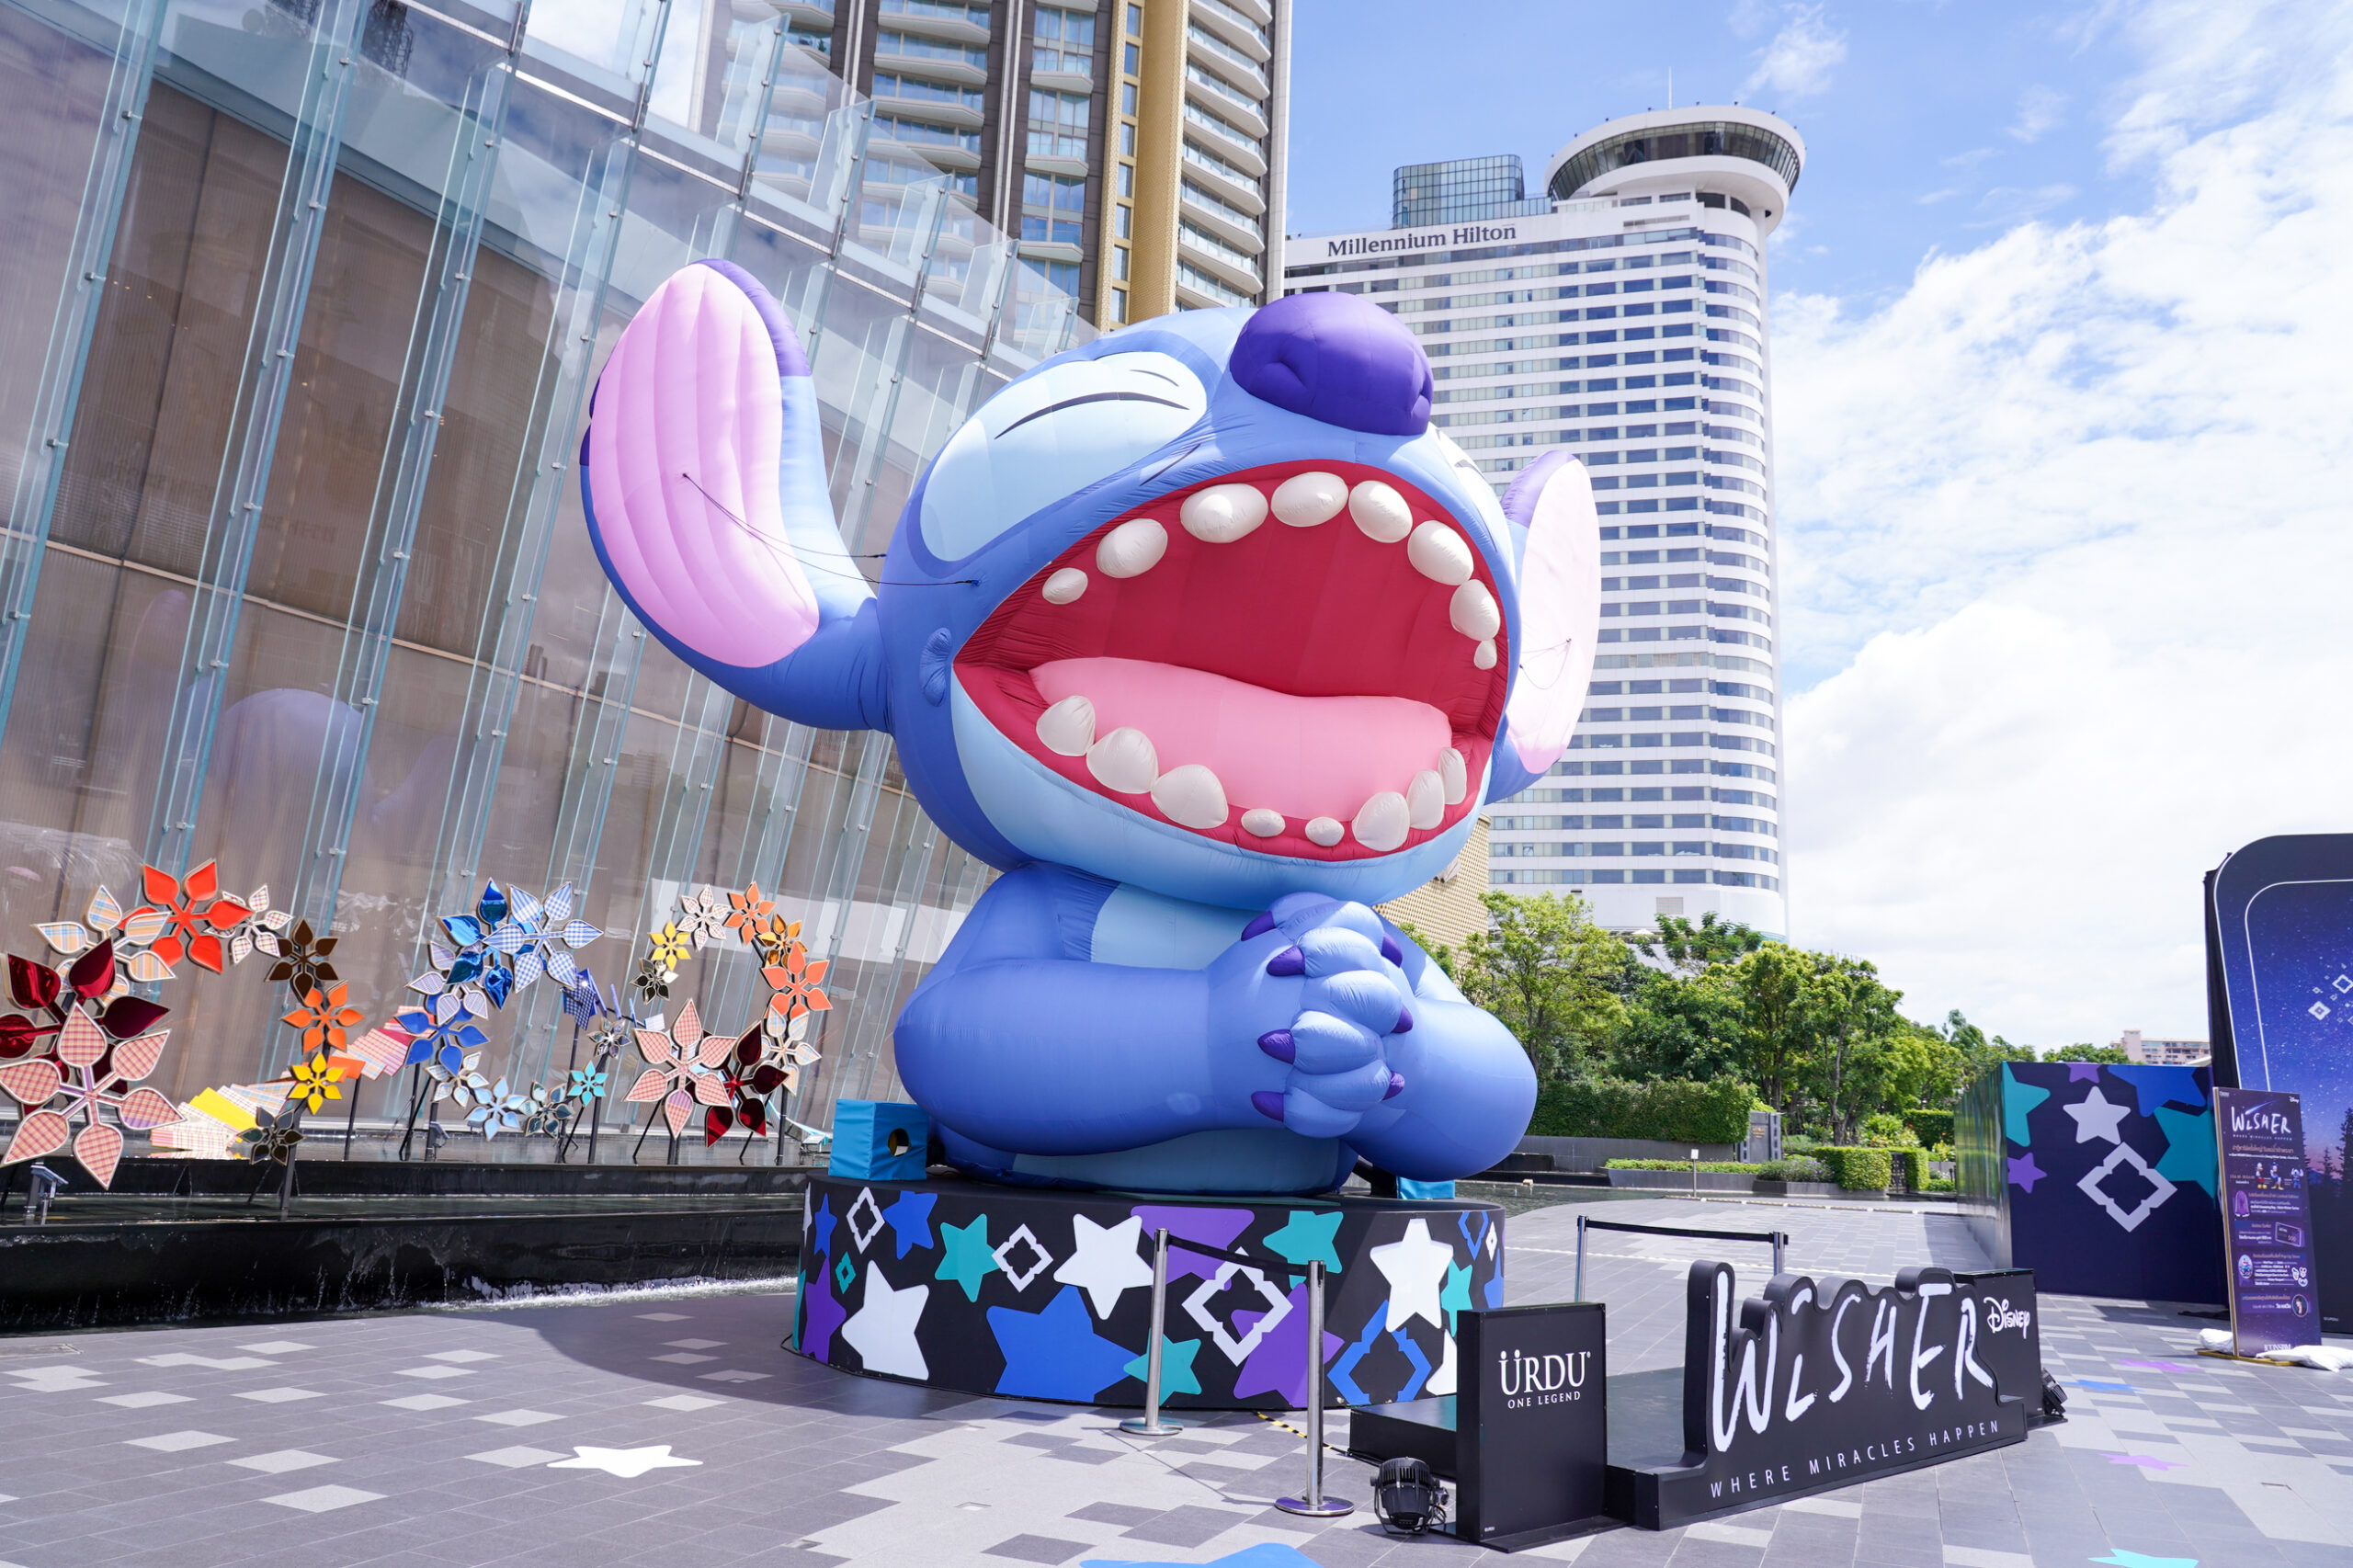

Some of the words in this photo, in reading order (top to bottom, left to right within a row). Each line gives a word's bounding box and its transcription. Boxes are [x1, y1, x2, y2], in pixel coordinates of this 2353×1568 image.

[1327, 233, 1446, 257] Millennium
[1452, 226, 1517, 244] Hilton
[1507, 1397, 1532, 1409] ONE
[1538, 1391, 1581, 1405] LEGEND
[1711, 1465, 1790, 1499] WHERE
[1809, 1437, 1915, 1475] MIRACLES
[1929, 1420, 1999, 1447] HAPPEN
